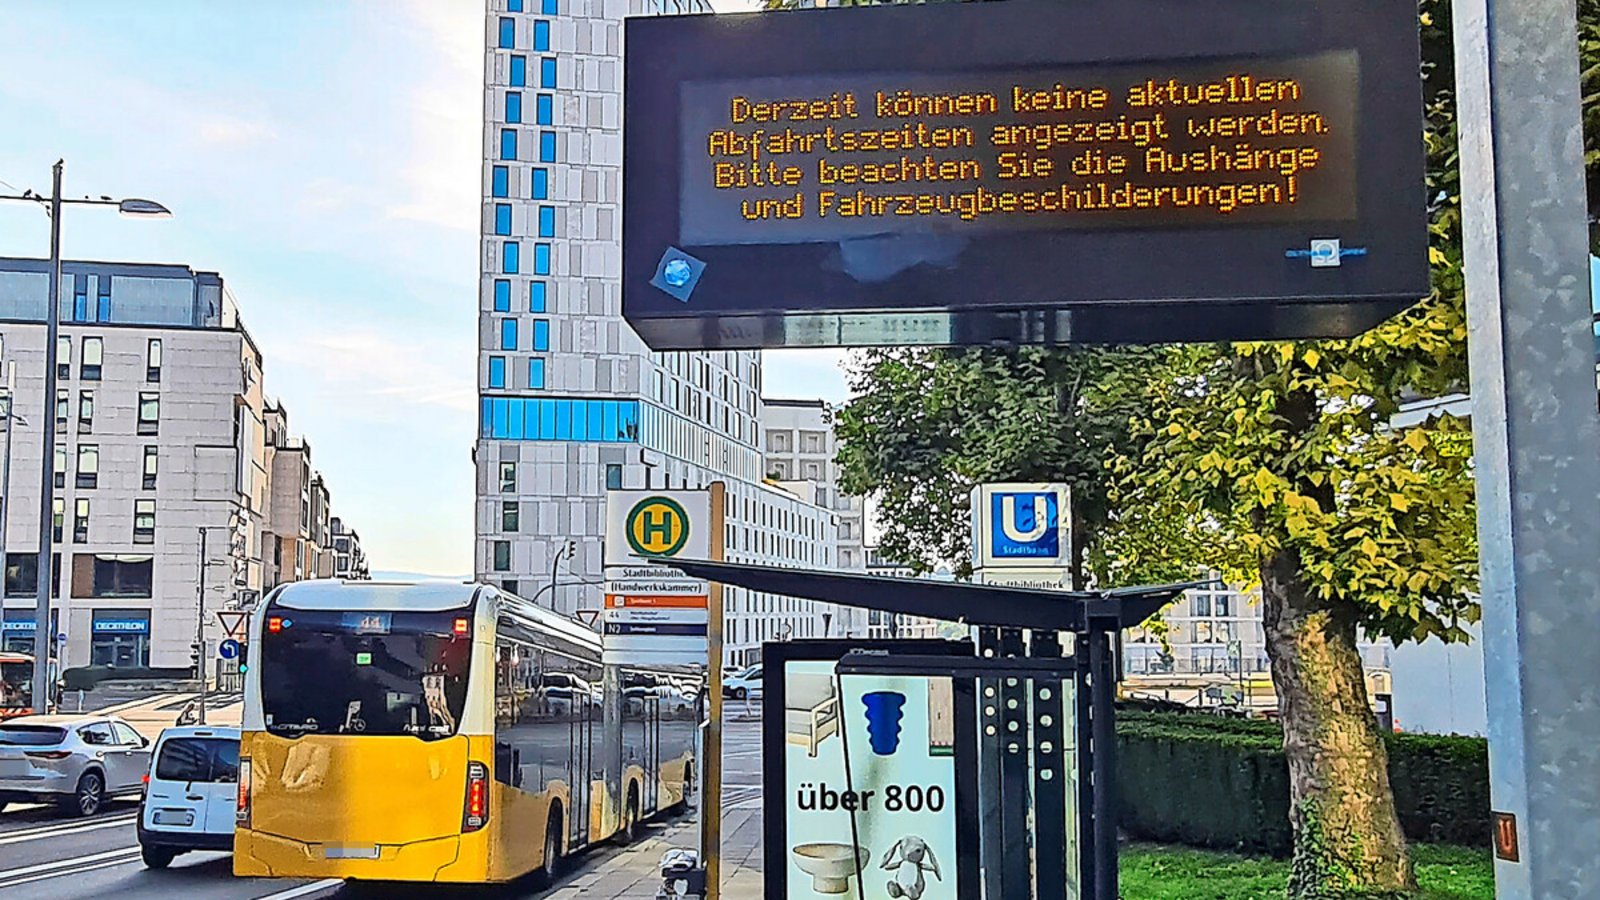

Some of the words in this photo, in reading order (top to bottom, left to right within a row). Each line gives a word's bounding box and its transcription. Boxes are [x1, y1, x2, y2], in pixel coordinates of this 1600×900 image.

[733, 95, 856, 122] Derzeit
[877, 92, 996, 115] können
[1015, 85, 1106, 110] keine
[1128, 77, 1298, 106] aktuellen
[710, 124, 971, 160] Abfahrtszeiten
[992, 114, 1168, 149] angezeigt
[1189, 109, 1328, 136] werden.
[717, 162, 801, 186] Bitte
[820, 157, 978, 183] beachten
[999, 153, 1051, 177] Sie
[1072, 150, 1126, 174] die
[1146, 144, 1318, 174] Aushänge
[743, 194, 801, 218] und
[820, 177, 1294, 218] Fahrzeugbeschilderungen!
[643, 511, 672, 545] H
[1002, 496, 1047, 542] U
[611, 583, 702, 593] (Handwerkskammer)
[95, 622, 145, 630] DECATHLON
[361, 616, 380, 629] 44
[608, 624, 621, 633] N2
[797, 783, 875, 812] über
[884, 785, 945, 812] 800
